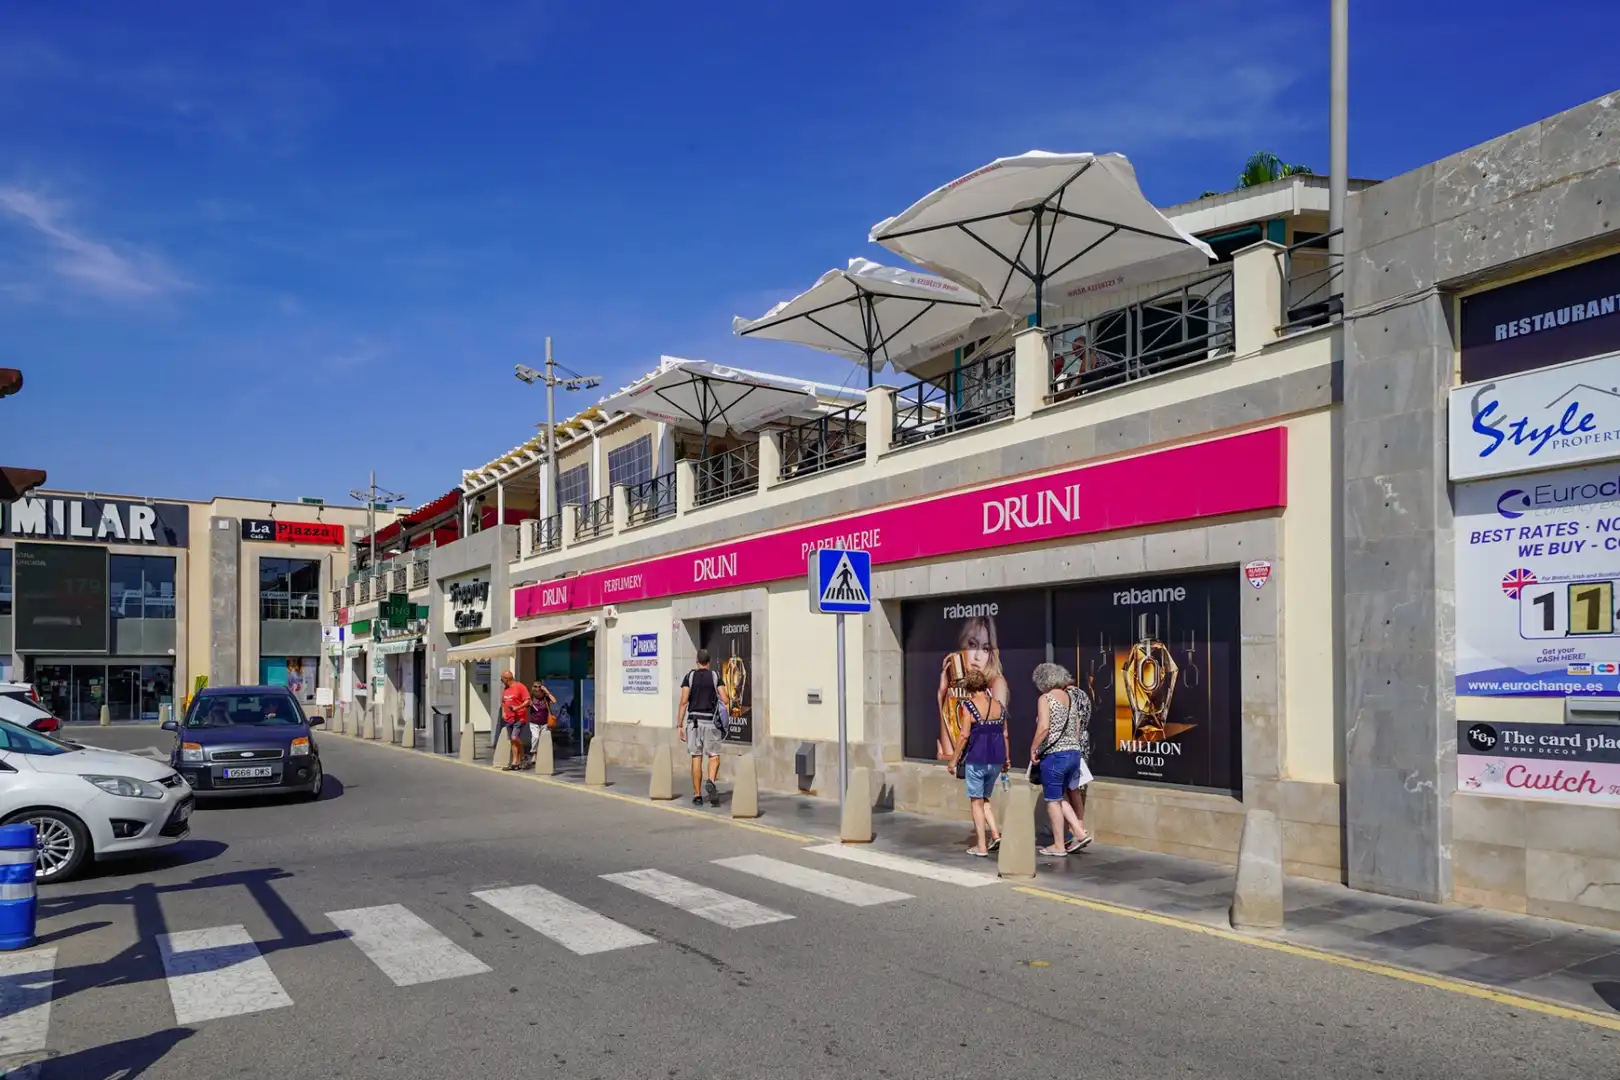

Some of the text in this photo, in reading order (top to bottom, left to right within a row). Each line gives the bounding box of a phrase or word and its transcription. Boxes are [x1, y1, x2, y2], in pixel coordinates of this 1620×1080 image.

[1472, 400, 1596, 457] Style
[1534, 475, 1620, 505] Euroc
[11, 497, 155, 540] MILAR
[982, 484, 1080, 535] DRUNI
[250, 521, 270, 533] La
[1470, 528, 1516, 544] BEST
[1518, 521, 1580, 540] RATES
[1518, 537, 1620, 558] WE BUY C
[694, 552, 737, 582] DRUNI
[604, 574, 643, 592] PERFUMERY
[542, 585, 567, 606] DRUNI
[1113, 587, 1186, 605] rabanne
[943, 602, 999, 619] rabanne
[722, 623, 750, 634] rabanne
[1557, 647, 1575, 656] your
[1468, 680, 1603, 694] www.eurochange.es
[728, 716, 748, 726] ILLION
[1120, 740, 1182, 756] MILLION
[1501, 731, 1535, 745] The
[1539, 732, 1581, 748] card
[1135, 755, 1165, 767] GOLD
